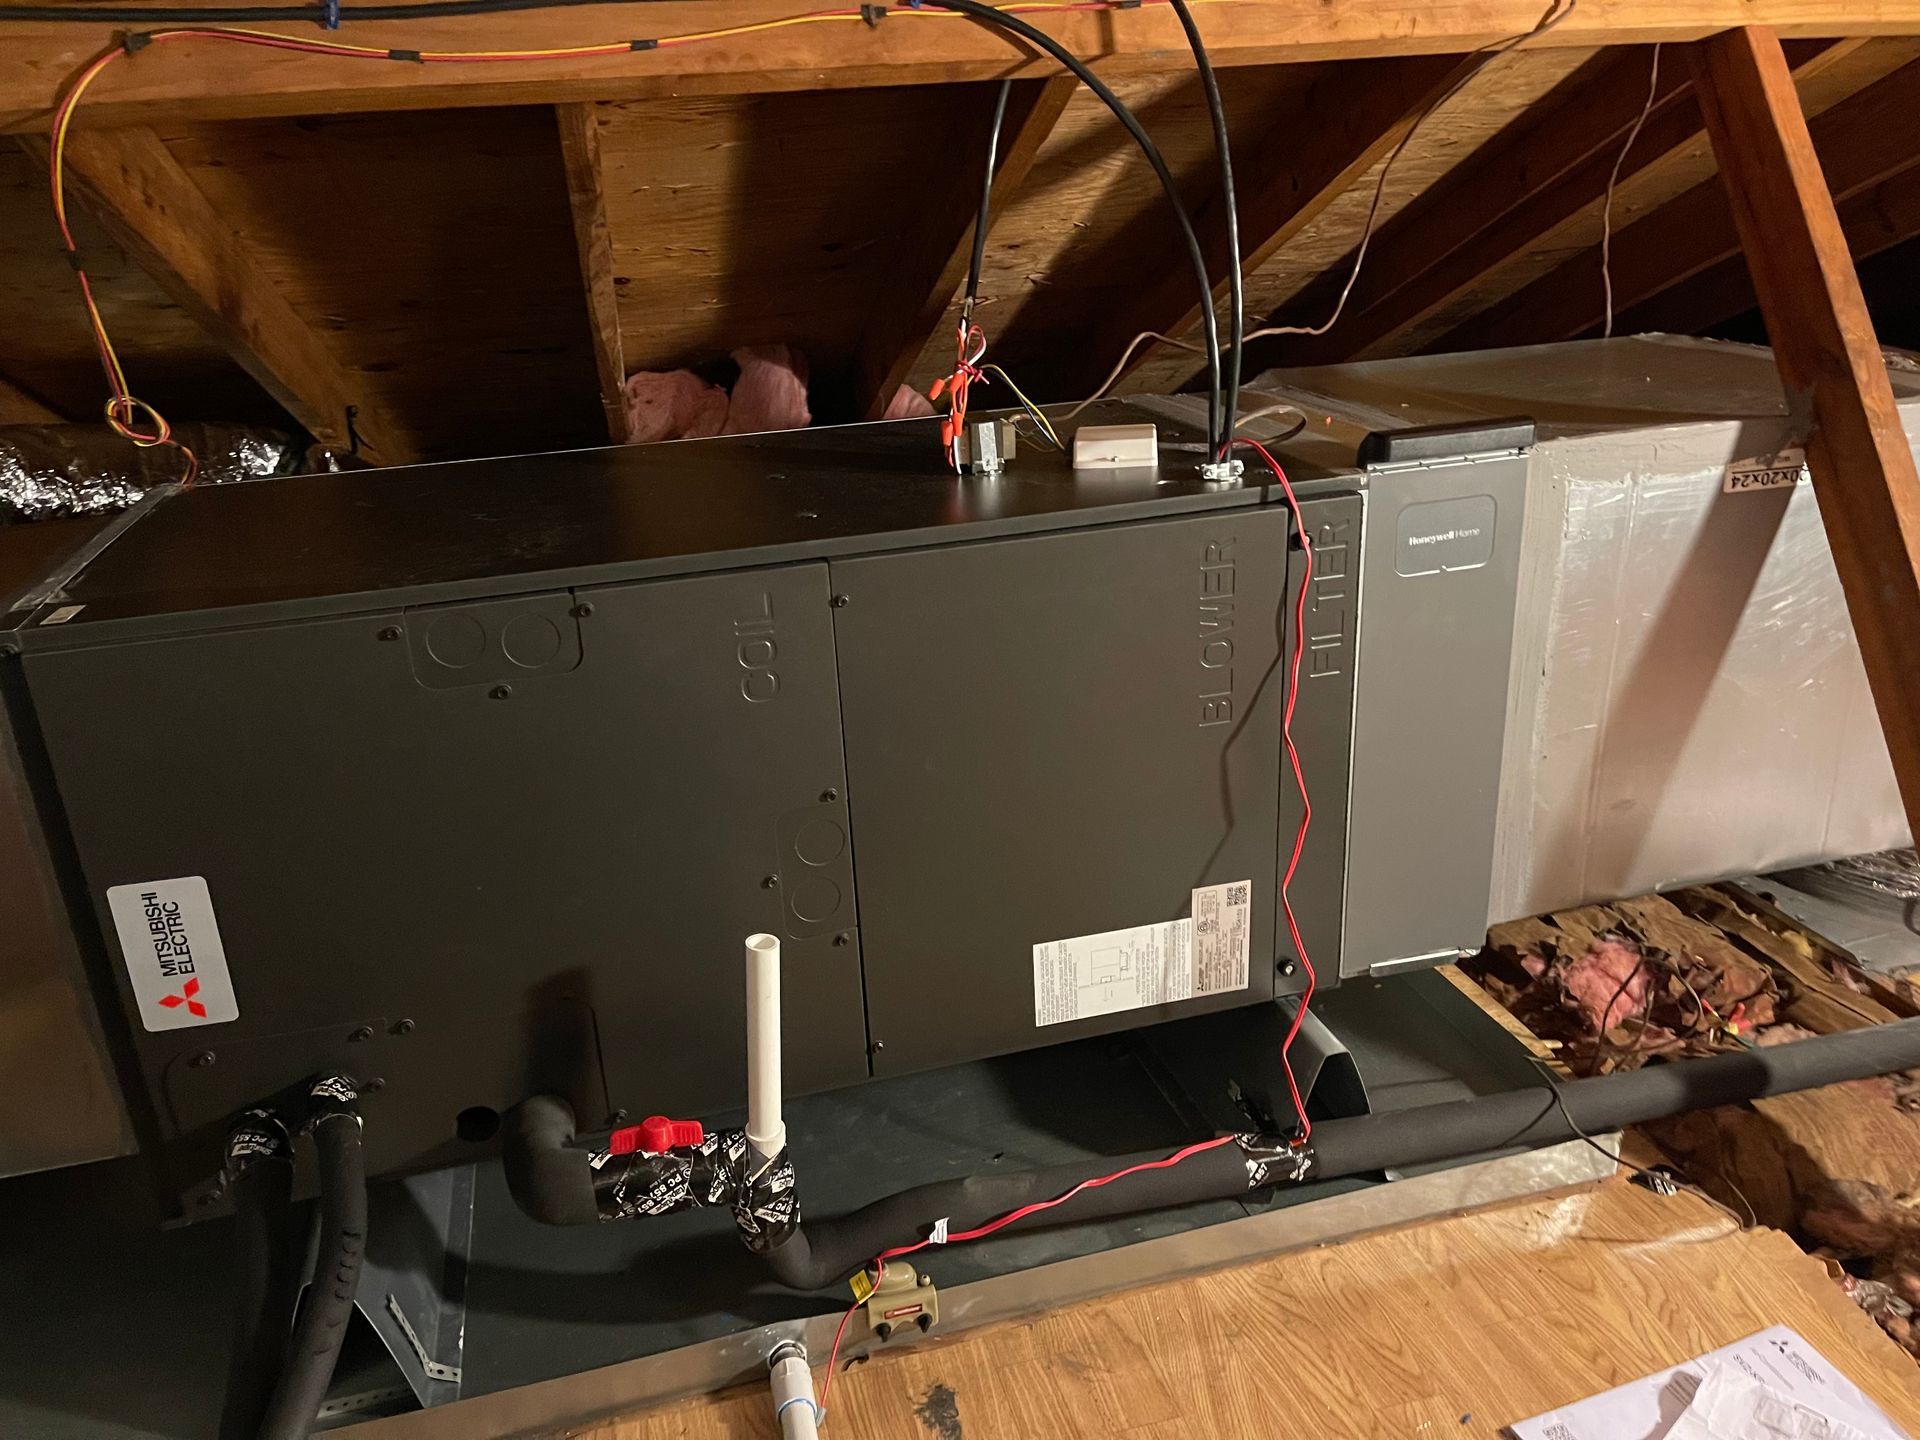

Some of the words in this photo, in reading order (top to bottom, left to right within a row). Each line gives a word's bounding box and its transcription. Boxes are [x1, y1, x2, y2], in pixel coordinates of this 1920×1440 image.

[1408, 530, 1454, 546] Honeywell
[1199, 536, 1237, 728] BLOWER
[1310, 519, 1350, 678] FILTER
[734, 591, 780, 703] COIL
[141, 892, 178, 977] MITSUBISHI
[162, 901, 196, 975] ELECTRIC
[667, 1173, 682, 1187] PC
